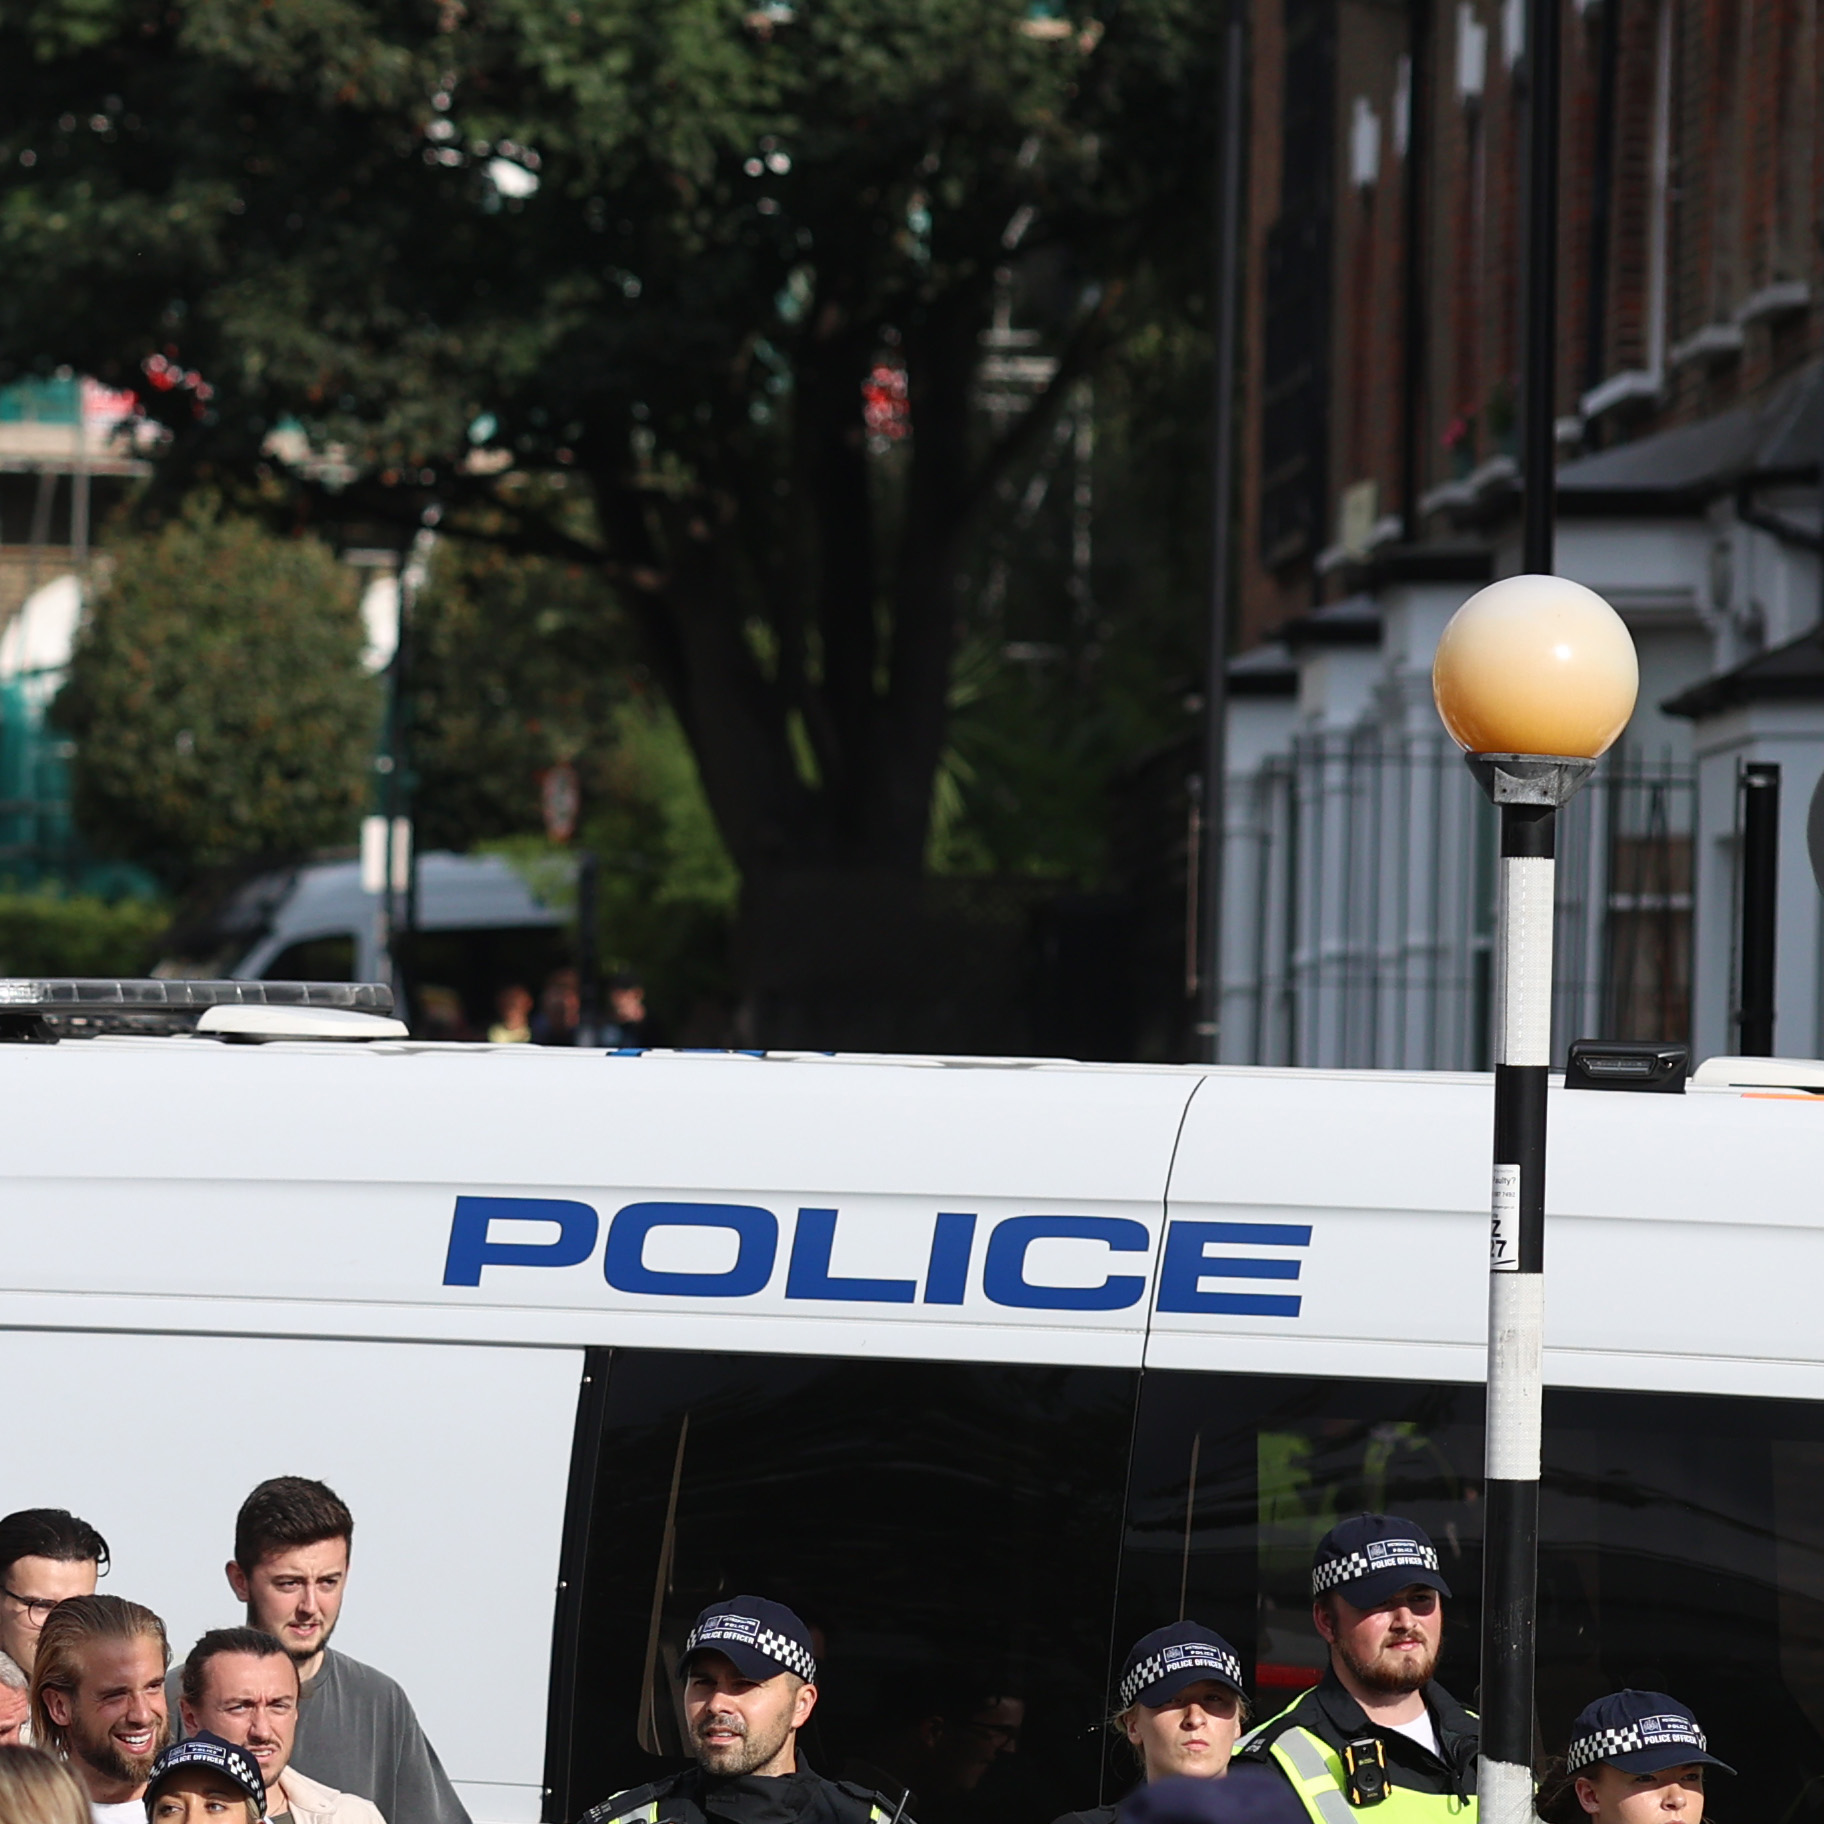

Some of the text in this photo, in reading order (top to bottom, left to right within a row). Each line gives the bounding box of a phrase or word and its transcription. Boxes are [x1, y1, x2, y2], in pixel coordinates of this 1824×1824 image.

[442, 1195, 1314, 1317] POLICE
[1371, 1557, 1396, 1570] POLICE
[723, 1631, 755, 1645] OFFICER
[1166, 1658, 1224, 1673] POLICE OFFICER
[1644, 1733, 1698, 1745] POLICE OFFICER
